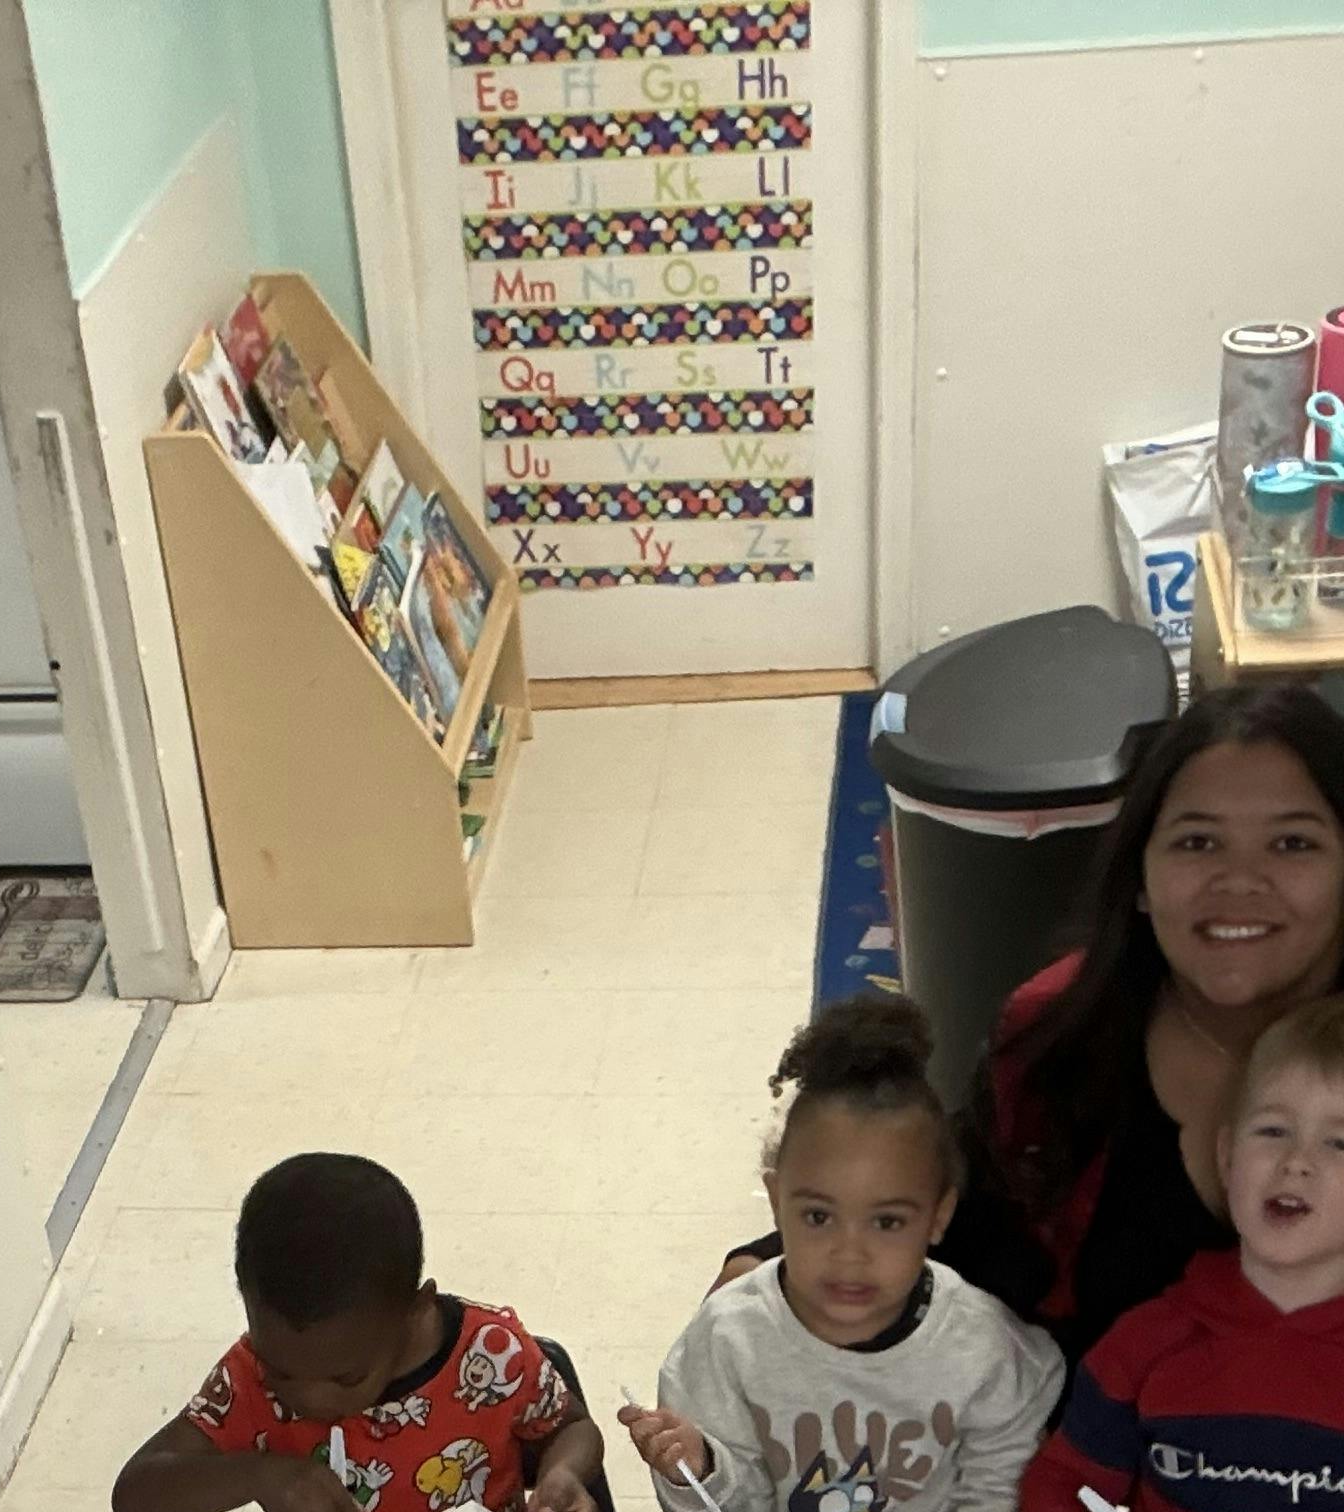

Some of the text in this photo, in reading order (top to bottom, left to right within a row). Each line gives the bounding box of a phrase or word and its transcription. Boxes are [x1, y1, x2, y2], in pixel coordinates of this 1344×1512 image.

[474, 57, 789, 112] Ee Ff Gg Hh
[483, 155, 791, 210] Ii Jj Kk Ll
[492, 254, 791, 304] Mm Nn Oo Pp
[499, 346, 793, 398] Qq Rr Ss Tt
[504, 438, 791, 480] Uu Vv Ww
[512, 524, 792, 568] Xx Yy Zz
